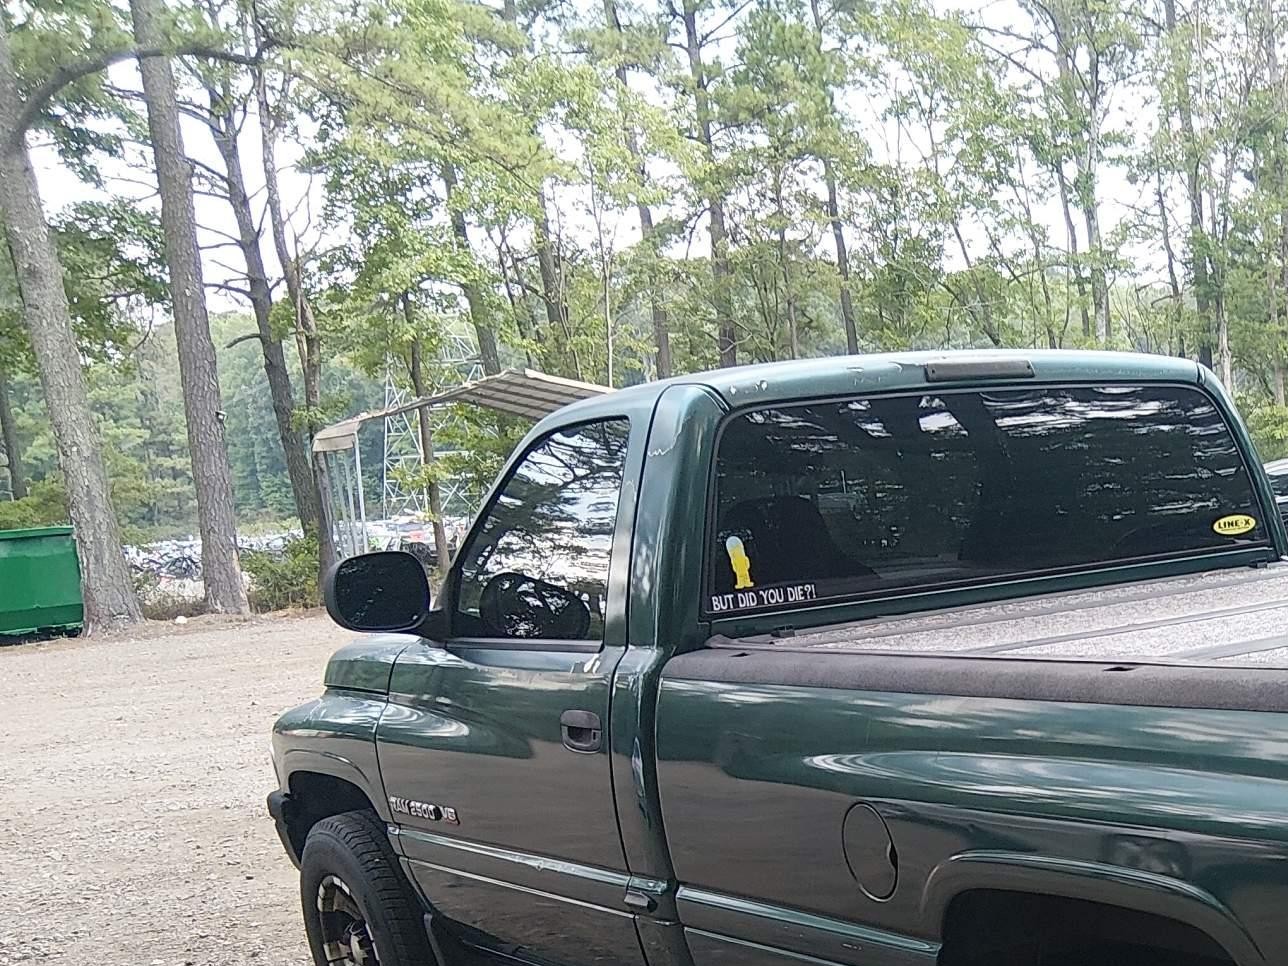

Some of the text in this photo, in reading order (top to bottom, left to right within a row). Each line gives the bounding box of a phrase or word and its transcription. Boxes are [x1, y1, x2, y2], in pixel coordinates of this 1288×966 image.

[1218, 518, 1251, 529] LINE-X
[711, 584, 817, 611] BUT DID YOU DIE?!
[410, 801, 436, 820] 2500
